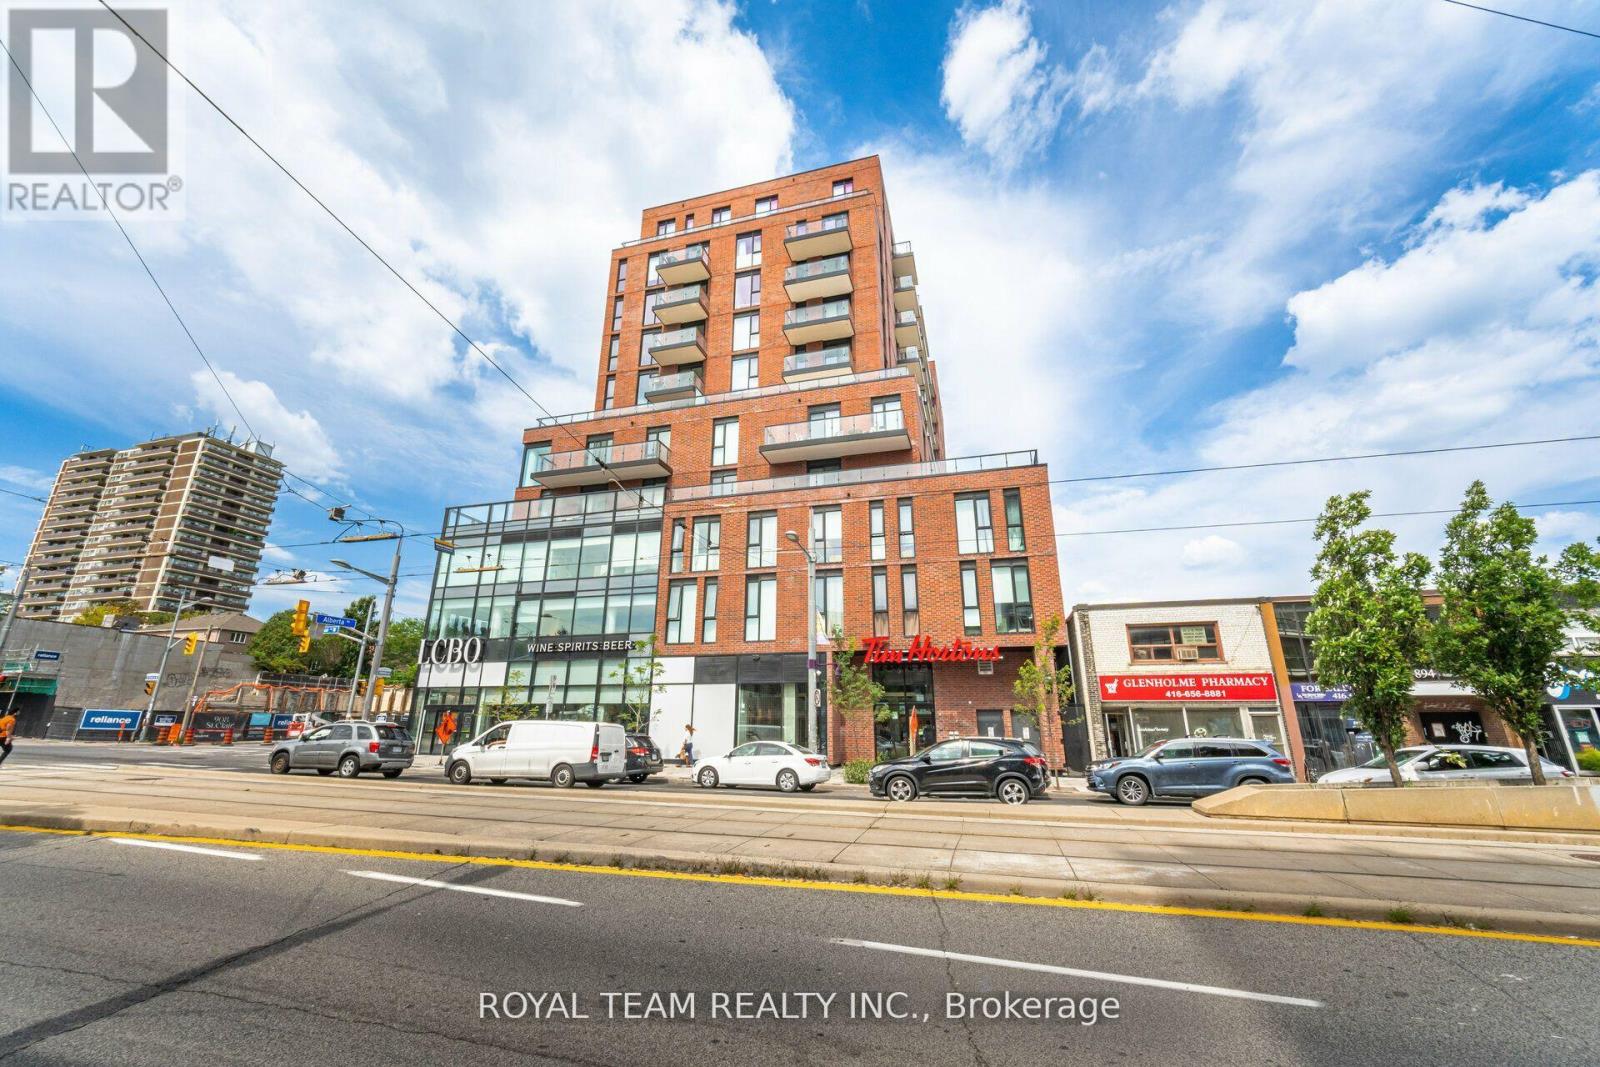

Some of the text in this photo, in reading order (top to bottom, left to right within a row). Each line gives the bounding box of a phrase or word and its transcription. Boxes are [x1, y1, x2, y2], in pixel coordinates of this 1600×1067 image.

[322, 616, 345, 625] Alberta
[417, 637, 482, 665] LCBO
[527, 640, 633, 653] WINE SPIRITS BEER
[862, 635, 1000, 663] Tim Hortons
[1414, 668, 1436, 679] 894
[1123, 676, 1269, 688] GLENHOLME PHARMACY
[1301, 685, 1321, 693] FOR
[90, 716, 132, 724] reliance
